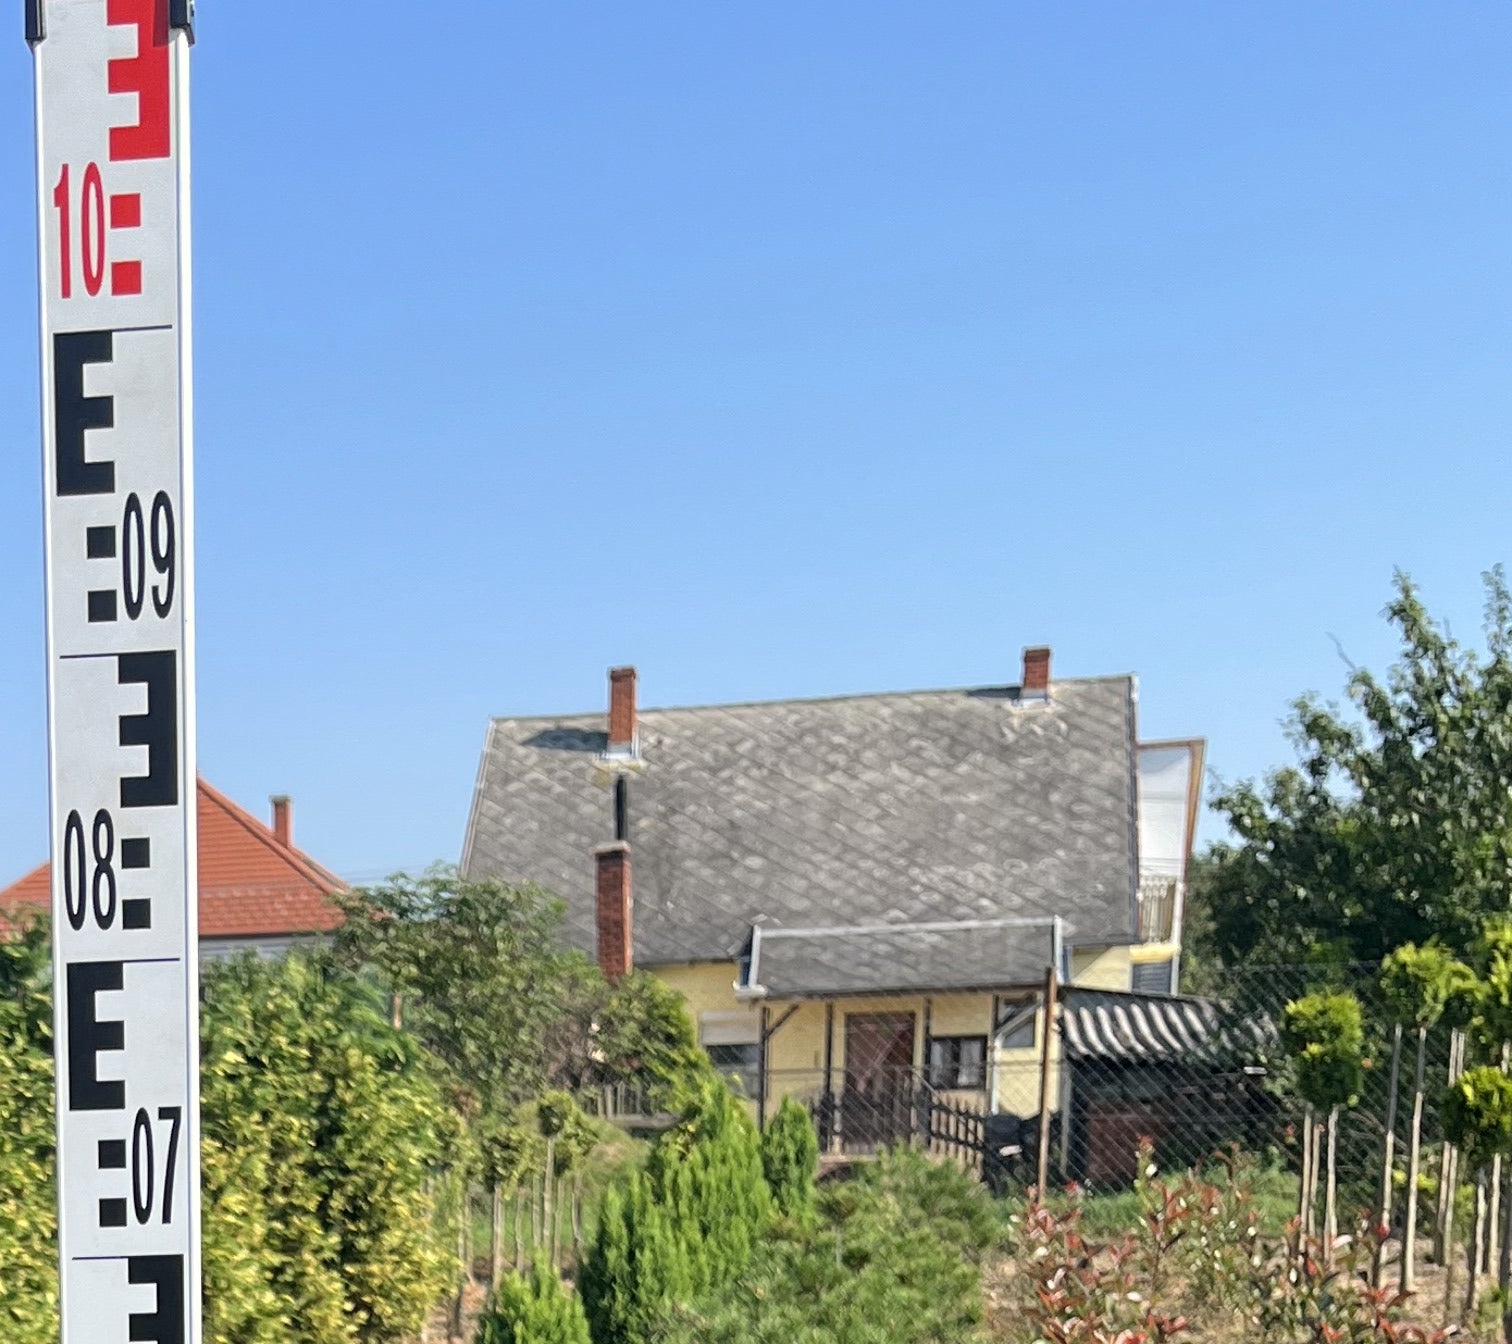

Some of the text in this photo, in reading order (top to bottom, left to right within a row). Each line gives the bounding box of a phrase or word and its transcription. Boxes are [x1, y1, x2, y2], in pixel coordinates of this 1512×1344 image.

[53, 161, 105, 299] 10
[122, 489, 176, 620] 09
[64, 808, 117, 931] 08
[132, 1106, 182, 1225] 07
